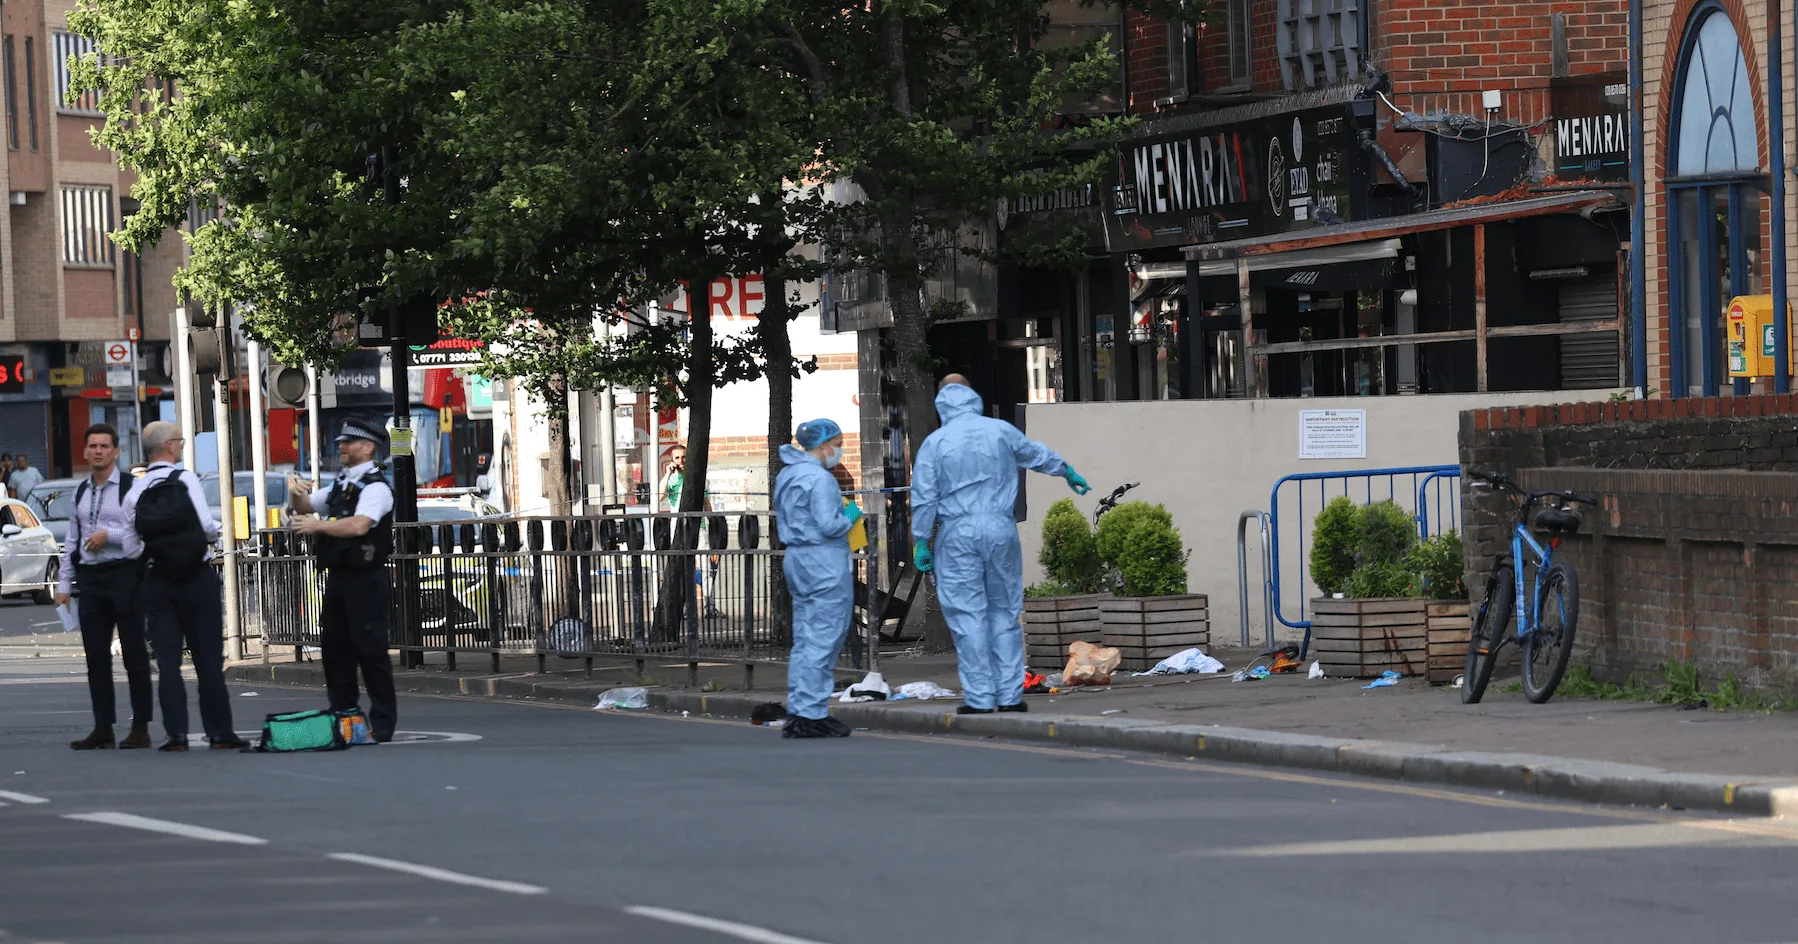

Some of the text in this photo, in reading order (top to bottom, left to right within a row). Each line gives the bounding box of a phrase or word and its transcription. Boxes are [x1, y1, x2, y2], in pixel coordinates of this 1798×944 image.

[1558, 113, 1625, 157] MENARA
[1133, 133, 1236, 215] MENARA
[1188, 214, 1212, 236] LOUNGE
[129, 327, 137, 340] E
